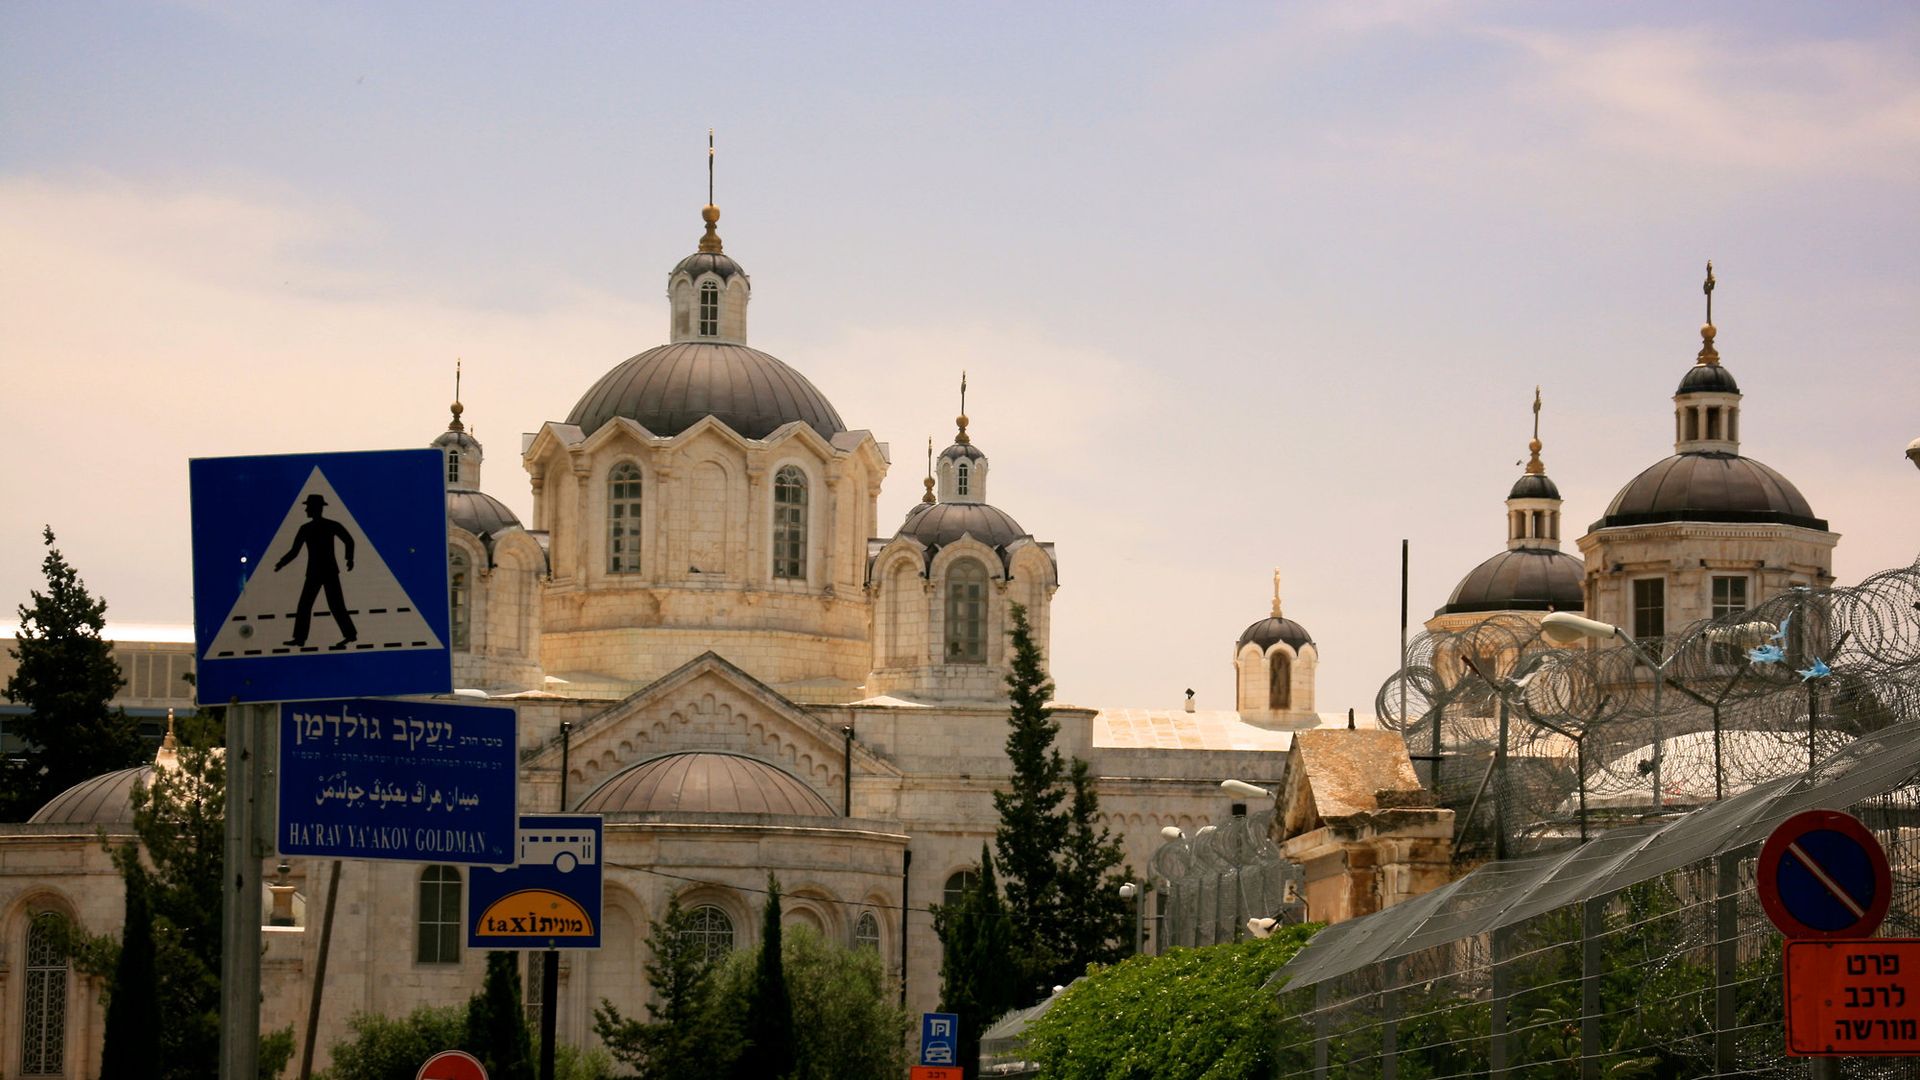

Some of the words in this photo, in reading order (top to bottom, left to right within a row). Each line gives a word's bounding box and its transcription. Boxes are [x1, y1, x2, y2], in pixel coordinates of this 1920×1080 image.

[459, 736, 479, 746] הרב
[481, 737, 503, 748] כיכר
[445, 786, 480, 813] ميدان
[289, 822, 344, 847] HA'RAV
[347, 825, 411, 850] YA'AKOV
[415, 828, 487, 854] GOLDMAN
[487, 912, 537, 932] taxi
[539, 916, 583, 933] מונית
[1846, 954, 1900, 975] פרט
[1844, 983, 1905, 1008] לרכב
[1835, 1019, 1917, 1041] מורשה
